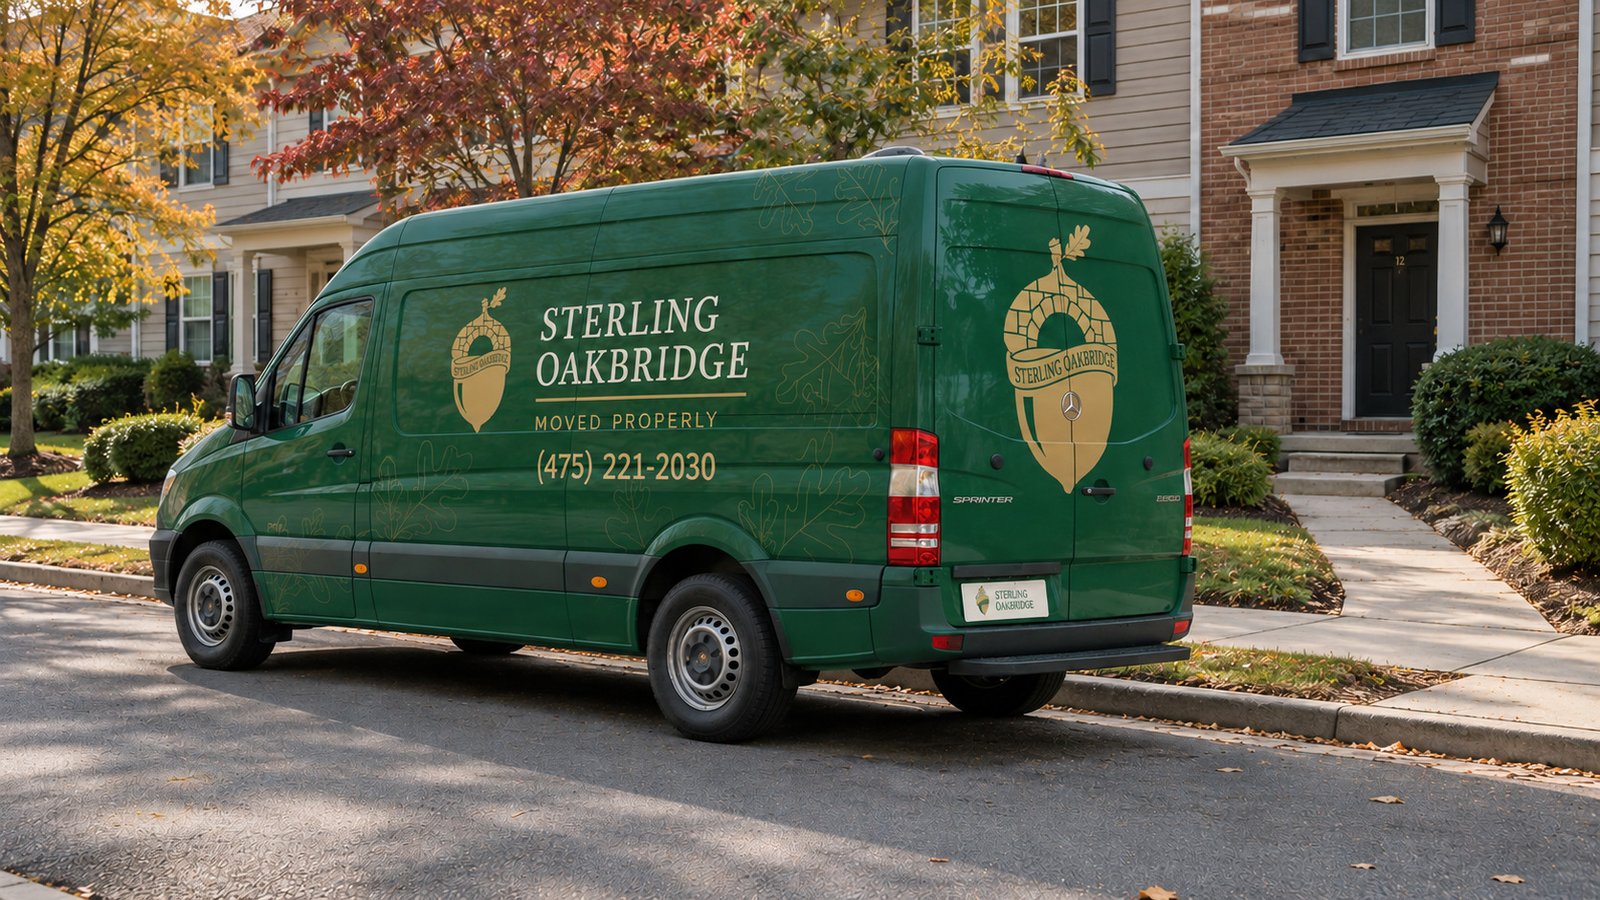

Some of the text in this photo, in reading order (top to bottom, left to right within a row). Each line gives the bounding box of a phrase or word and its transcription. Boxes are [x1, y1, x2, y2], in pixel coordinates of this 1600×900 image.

[1395, 255, 1405, 266] 12
[540, 295, 719, 341] STERLING
[536, 341, 749, 387] OAKBRIDGE
[1014, 349, 1115, 384] STERLING OAKBRIDGE
[535, 411, 718, 431] MOVED PROPERLY
[537, 449, 716, 485] (475) 221-2030
[952, 496, 1014, 504] SPRINTER
[995, 589, 1028, 600] STERLING
